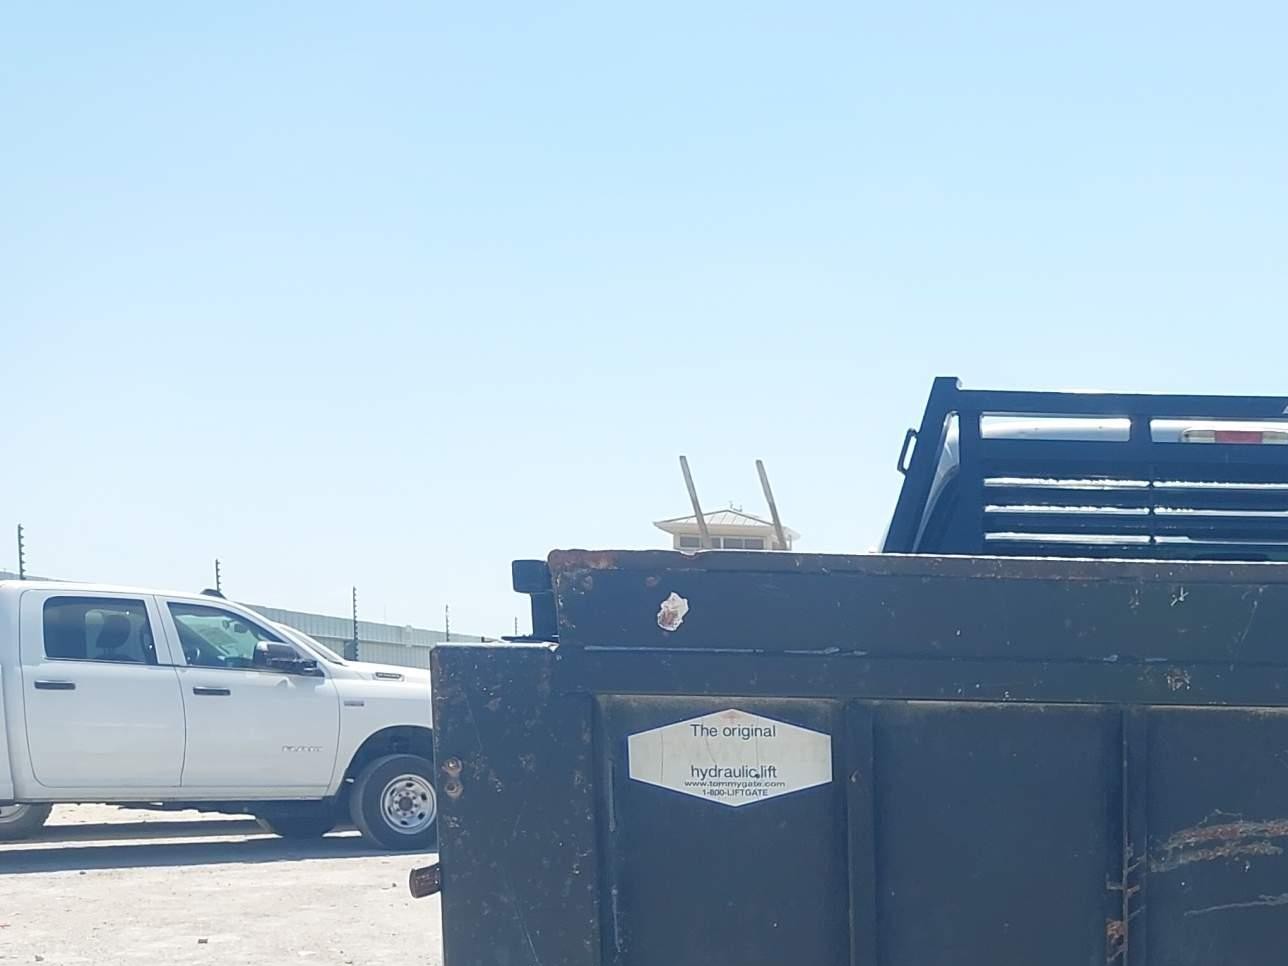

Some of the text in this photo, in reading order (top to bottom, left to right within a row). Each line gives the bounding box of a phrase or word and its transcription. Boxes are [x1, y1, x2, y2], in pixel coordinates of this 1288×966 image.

[690, 724, 776, 740] The original
[690, 764, 777, 780] hydraulic lift
[684, 780, 786, 788] www.tommygate.com
[702, 788, 769, 797] 1-800-LIFTGATE
